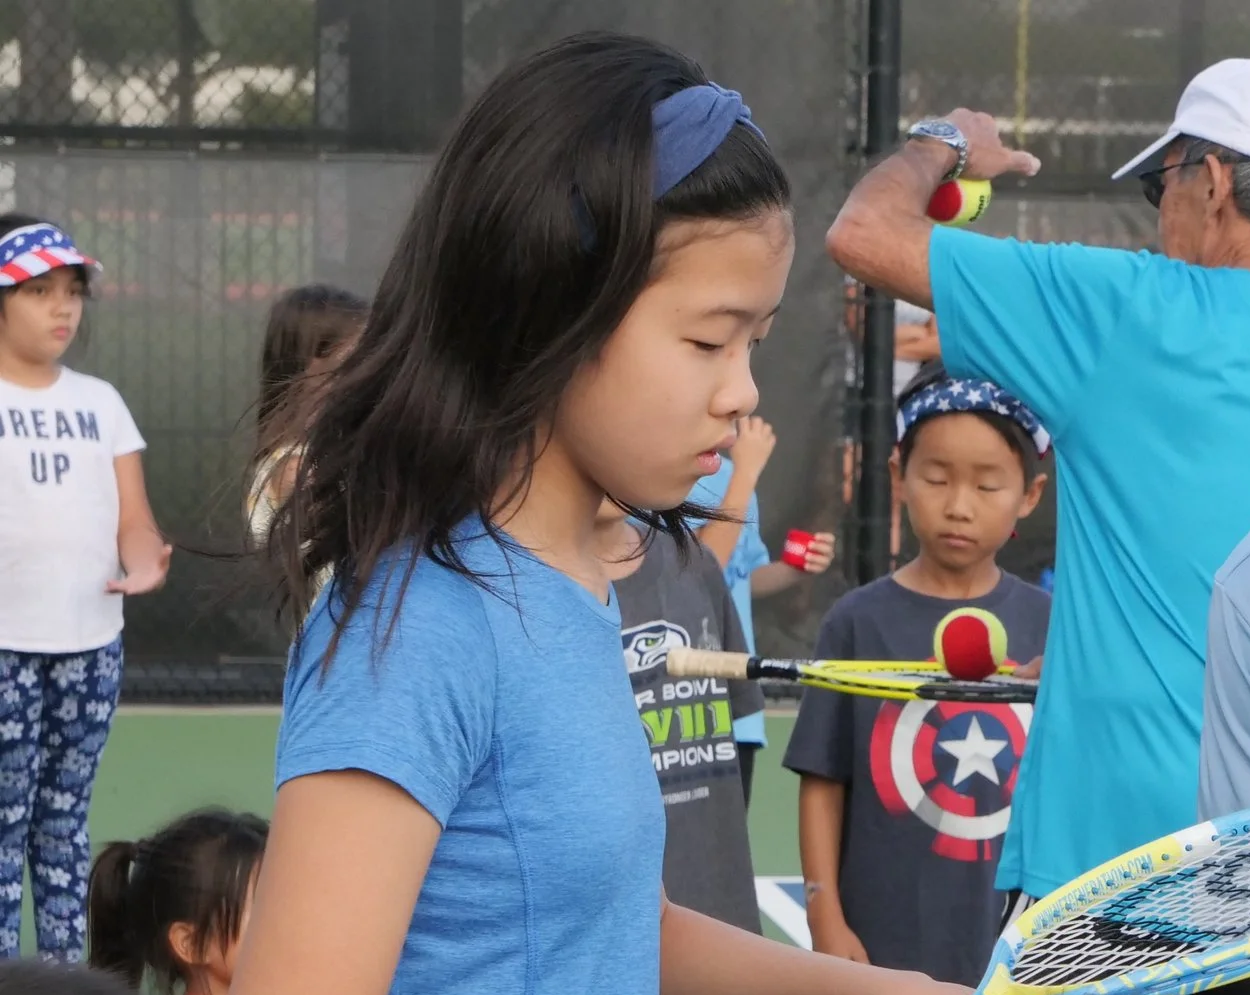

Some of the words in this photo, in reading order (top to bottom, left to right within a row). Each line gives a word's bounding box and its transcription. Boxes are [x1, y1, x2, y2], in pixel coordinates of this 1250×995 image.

[30, 451, 71, 485] UP
[662, 677, 728, 701] BOWL
[640, 700, 732, 748] VIII
[652, 741, 737, 772] PIONS
